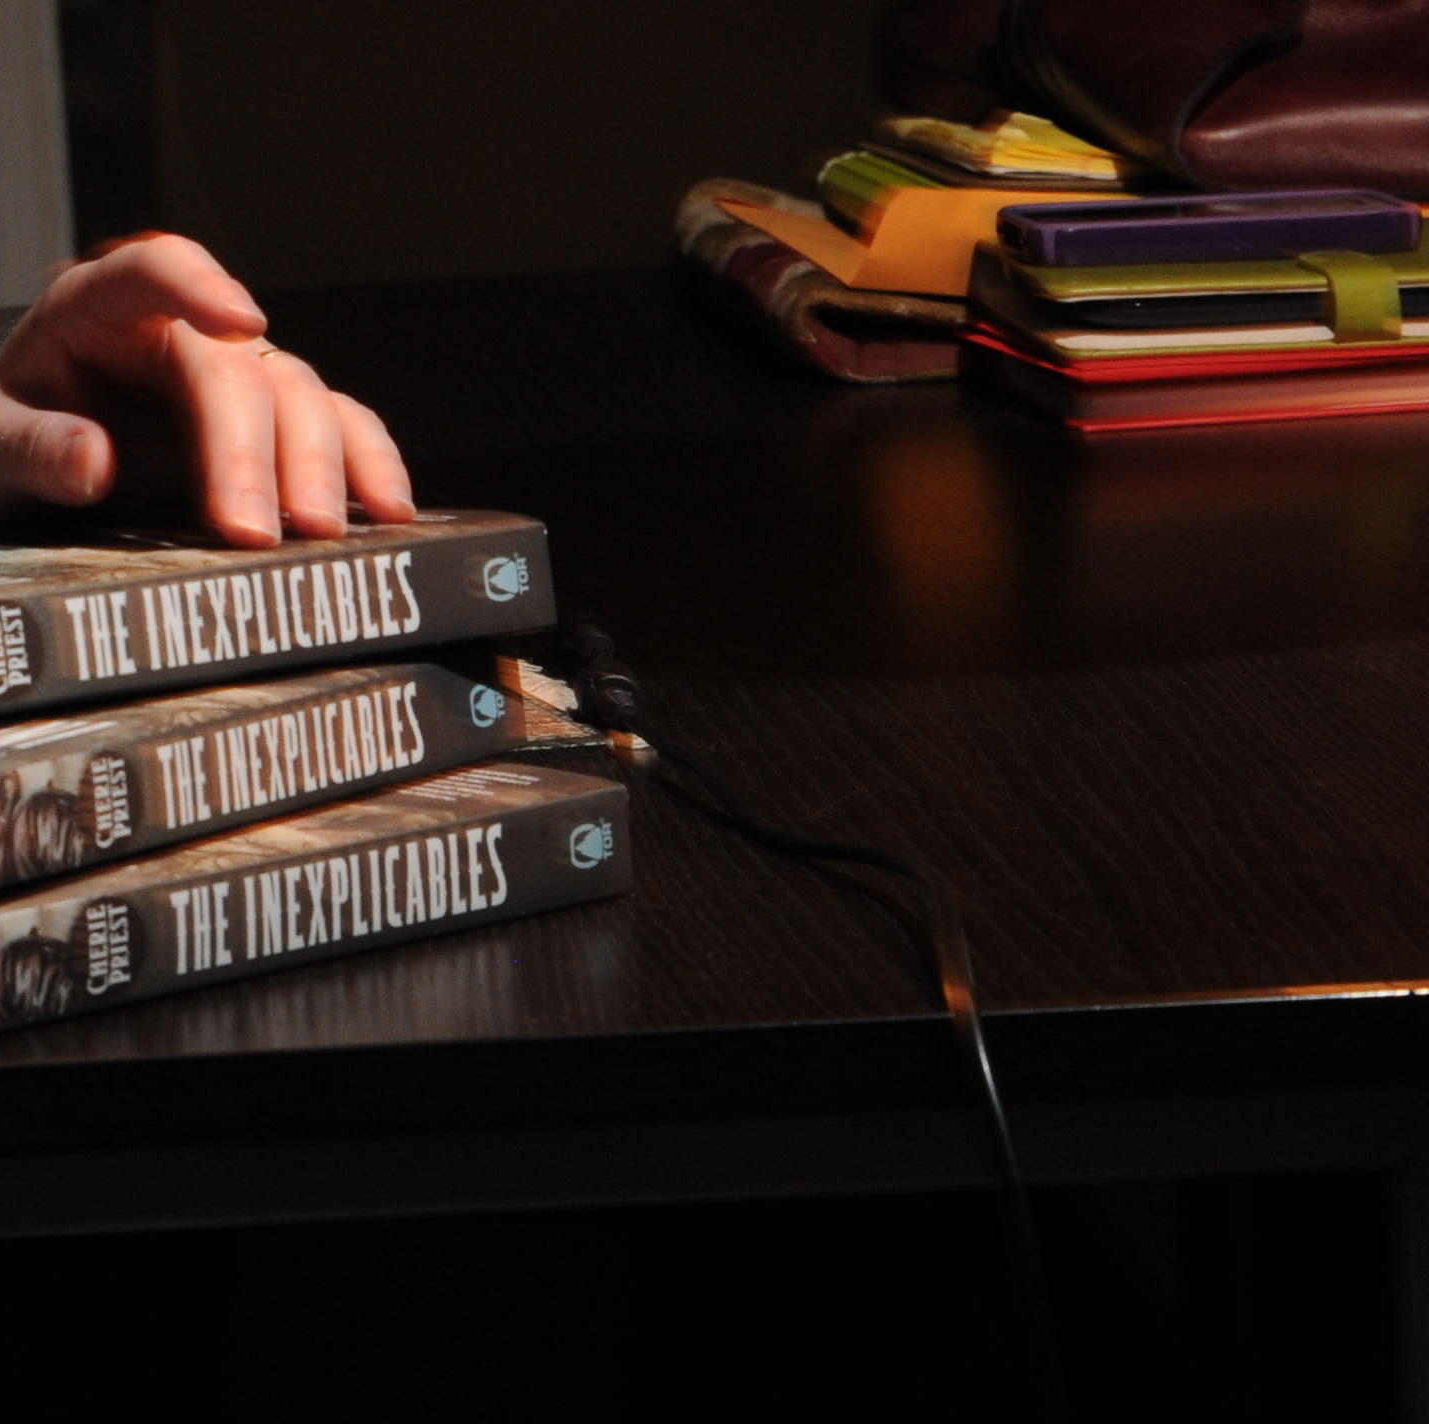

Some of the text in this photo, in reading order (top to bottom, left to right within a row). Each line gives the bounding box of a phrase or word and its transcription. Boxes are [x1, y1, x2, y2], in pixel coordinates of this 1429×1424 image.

[1, 604, 33, 688] PRIEST
[65, 550, 421, 682] THE INEXPLICABLES
[109, 756, 133, 839] PRIEST
[156, 681, 425, 829] THE INEXPLICABLES
[92, 755, 115, 849] CHERIE
[108, 903, 132, 987] PRIEST
[170, 822, 508, 975] THE INEXPLICABLES
[86, 903, 109, 996] CHERIE
